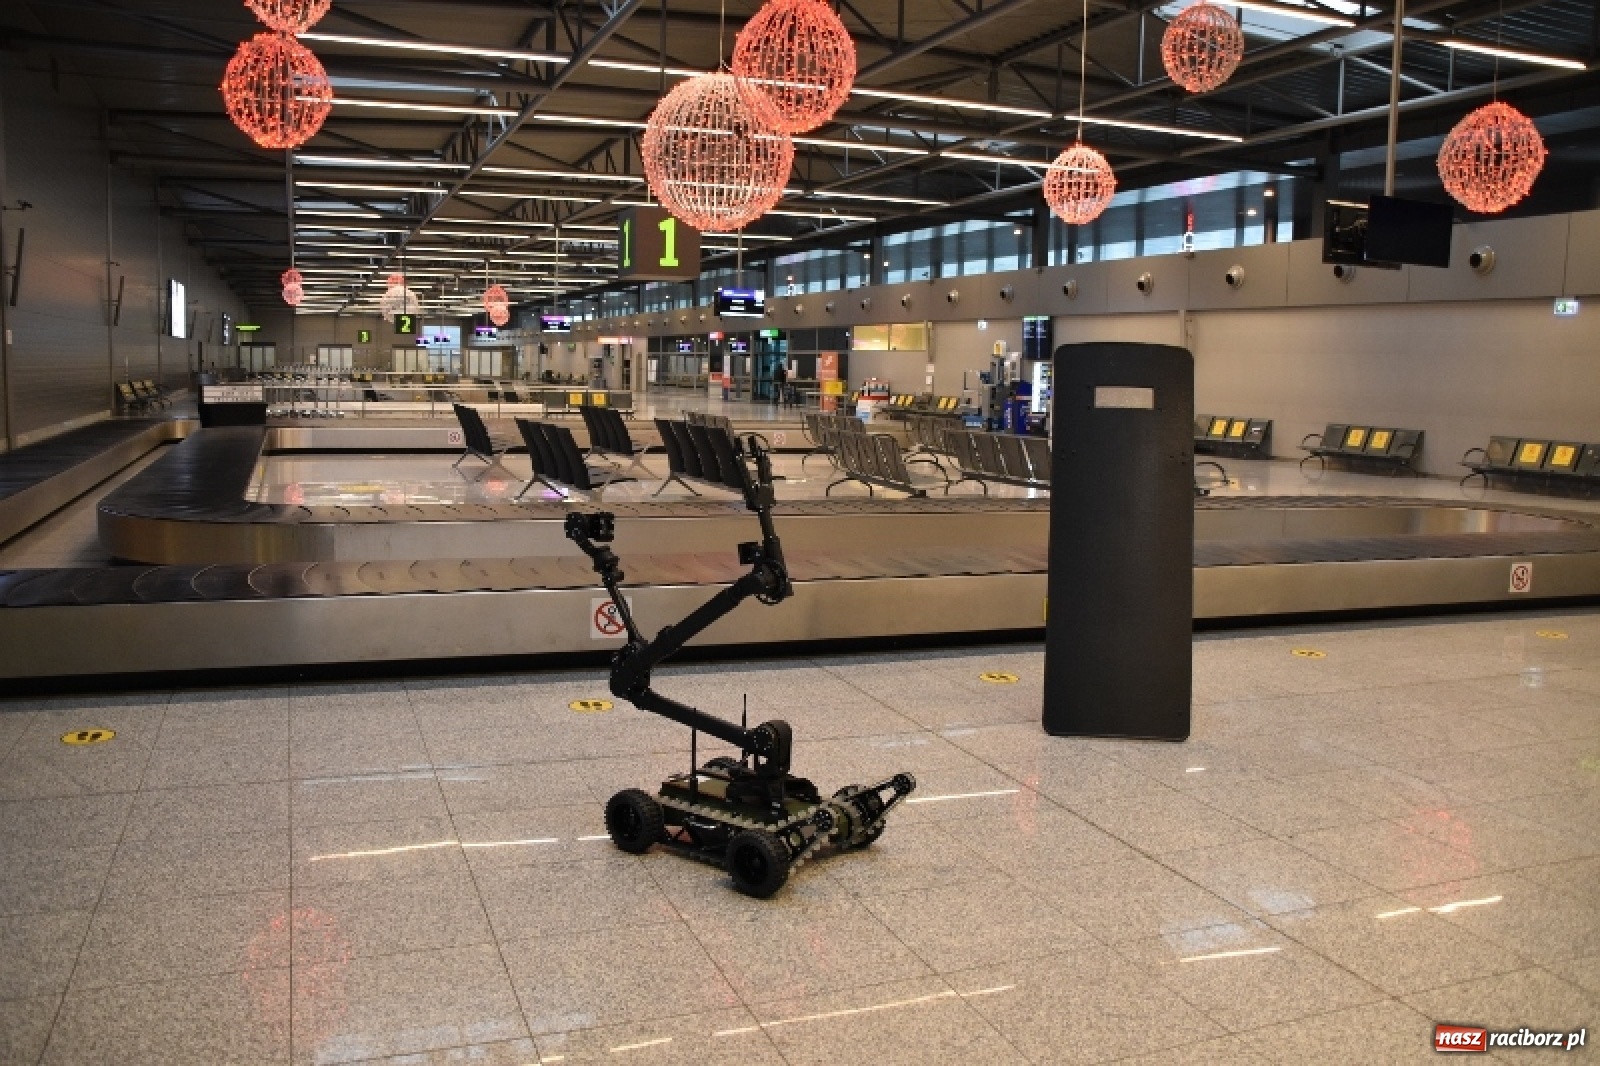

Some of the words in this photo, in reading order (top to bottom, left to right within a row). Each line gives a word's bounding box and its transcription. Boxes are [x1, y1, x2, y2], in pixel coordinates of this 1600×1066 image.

[623, 218, 631, 267] 1
[658, 217, 679, 267] 1
[401, 315, 411, 333] 2
